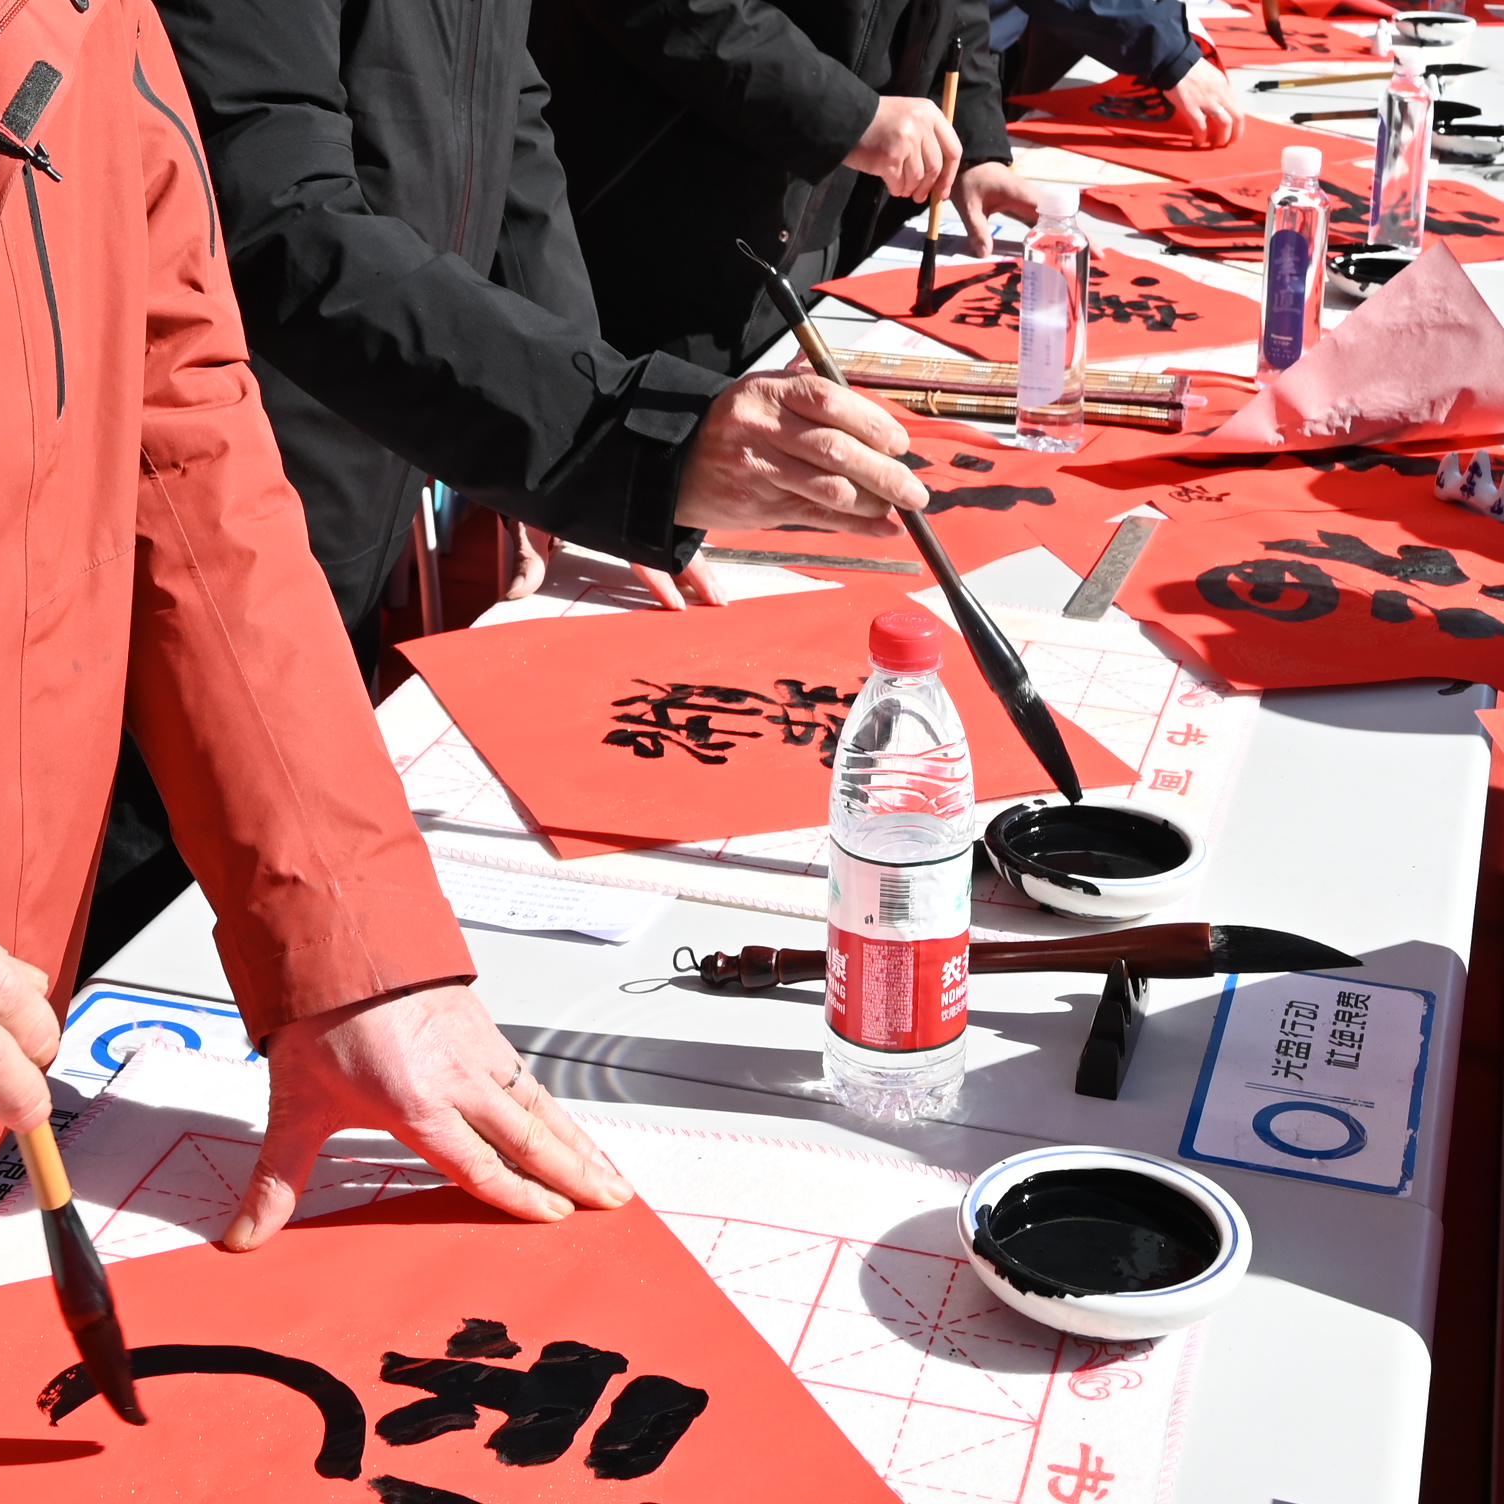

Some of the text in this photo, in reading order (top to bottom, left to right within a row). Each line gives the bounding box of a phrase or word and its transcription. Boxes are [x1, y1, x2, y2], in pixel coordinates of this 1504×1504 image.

[1148, 723, 1209, 796] 书画
[1271, 1000, 1320, 1081] 光盘行动
[1324, 991, 1372, 1070] 杜绝浪费
[1047, 1442, 1115, 1504] 书
